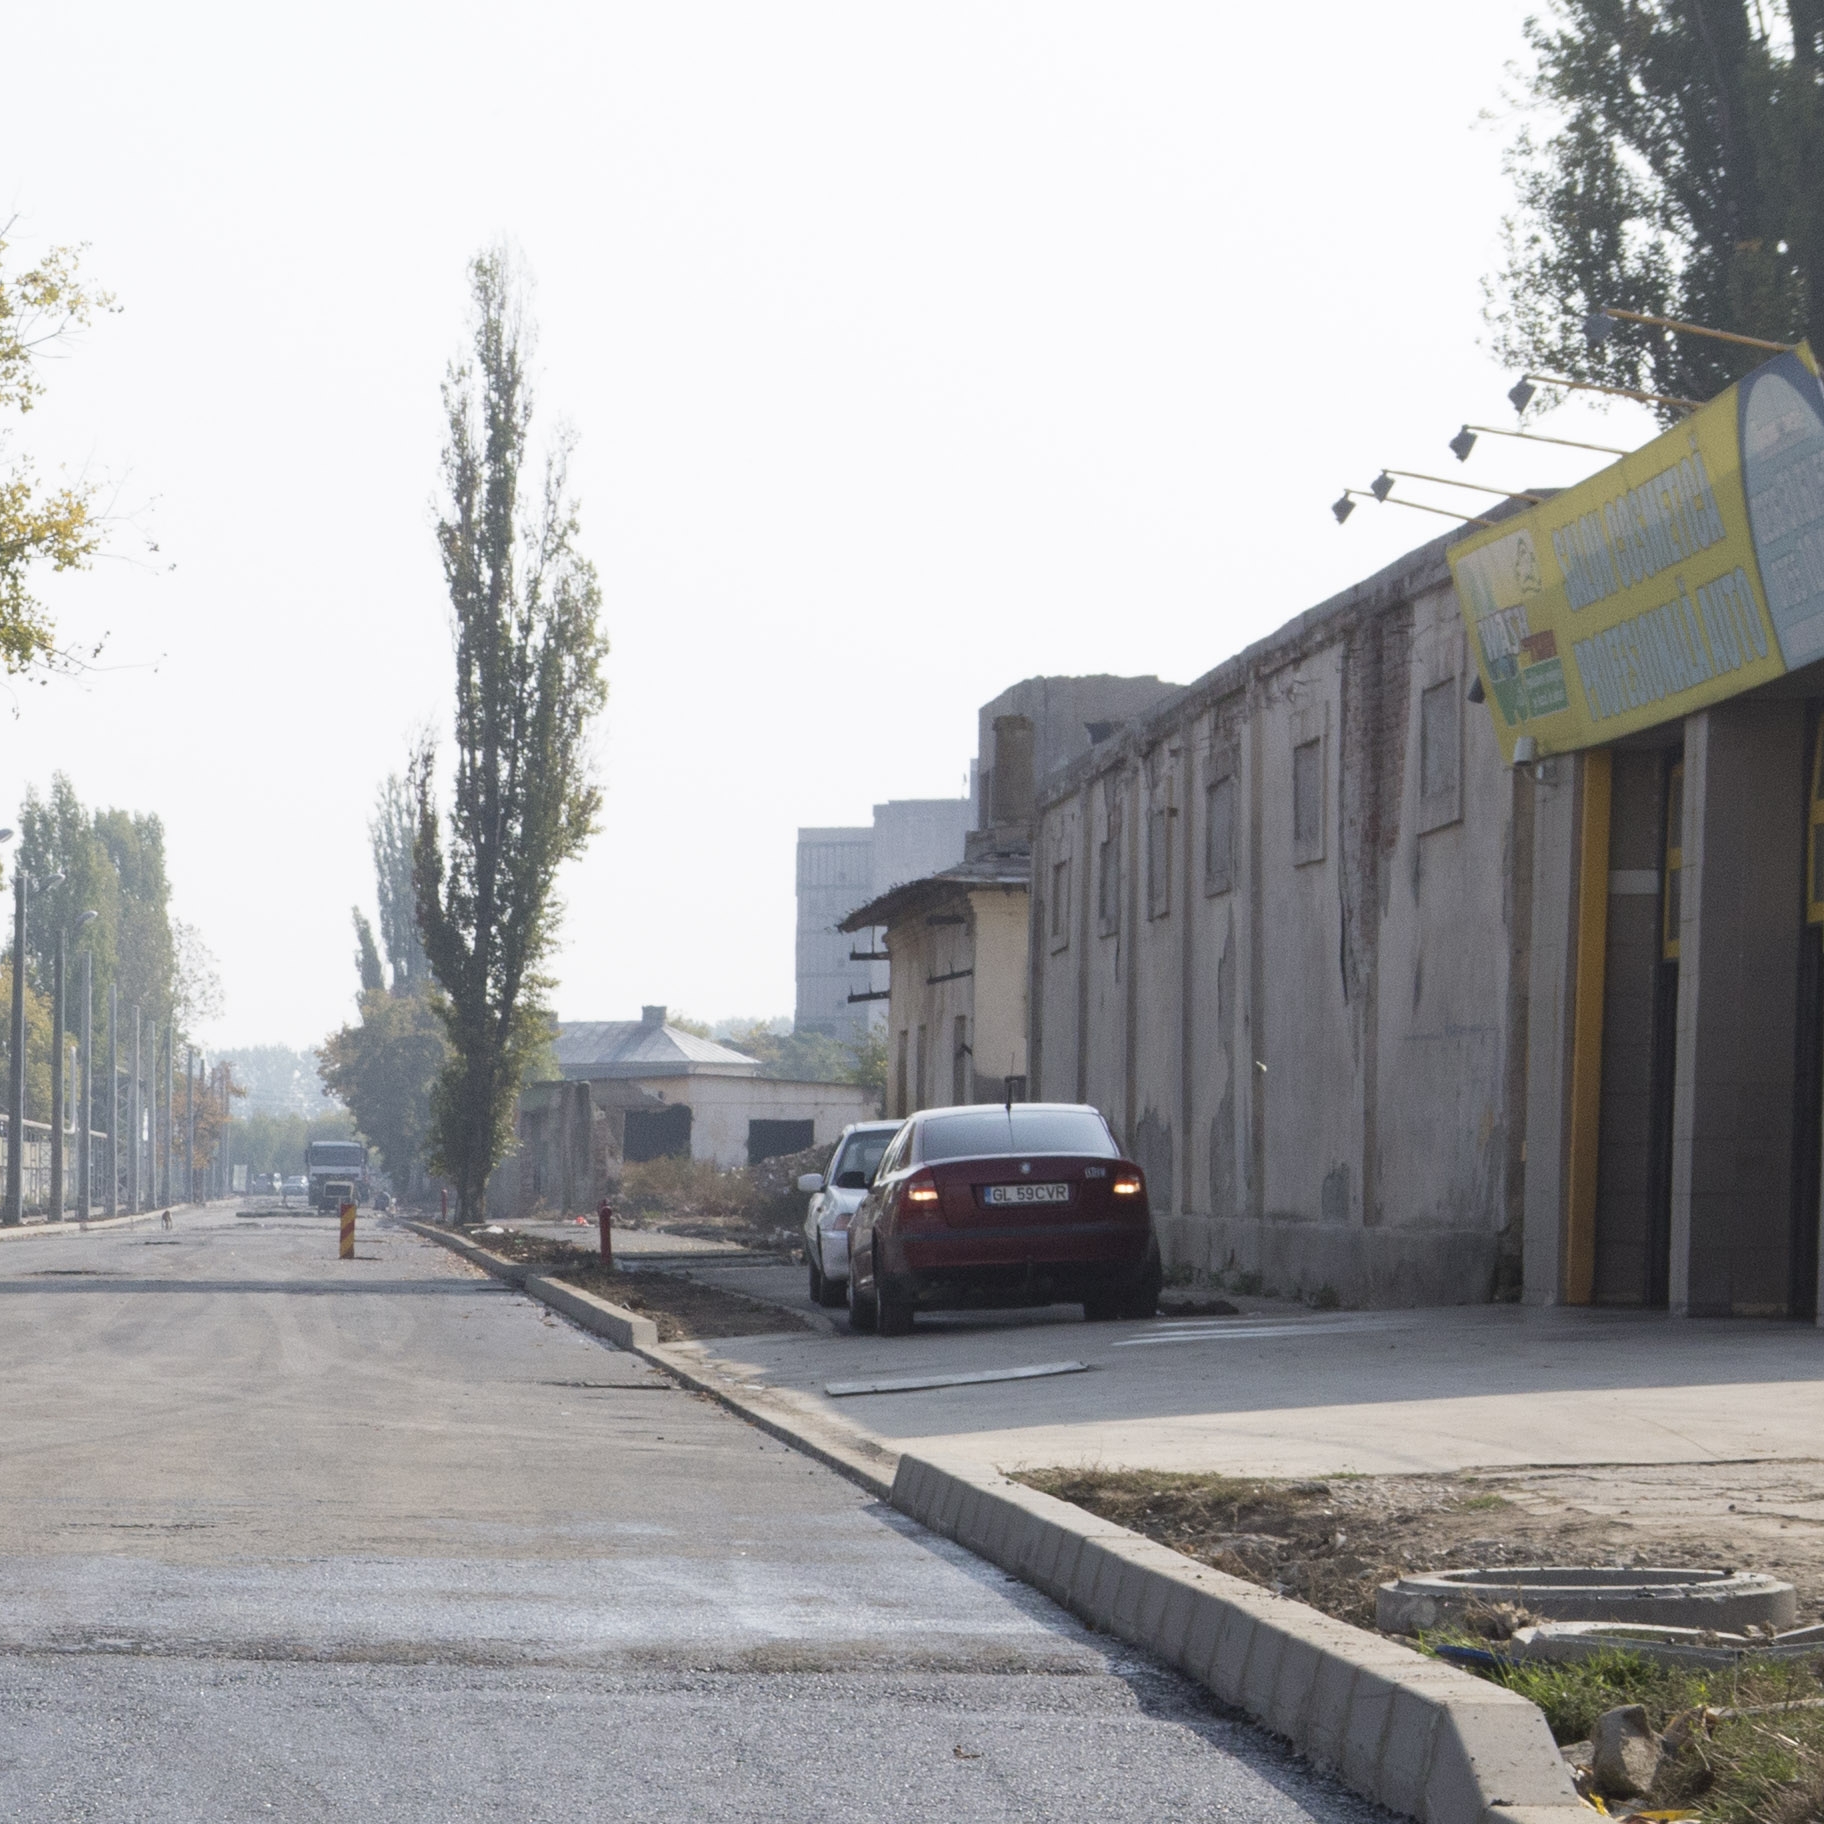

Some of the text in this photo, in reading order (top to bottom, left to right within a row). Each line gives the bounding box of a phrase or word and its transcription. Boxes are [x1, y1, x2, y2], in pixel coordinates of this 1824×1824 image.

[1551, 510, 1619, 613] SALON
[1602, 433, 1727, 588] COSMETICĂ
[1477, 605, 1531, 663] WASH
[1572, 576, 1714, 723] PROFESIONALĂ
[1695, 565, 1770, 676] AUTO
[992, 1184, 1067, 1202] GL 59CVR
